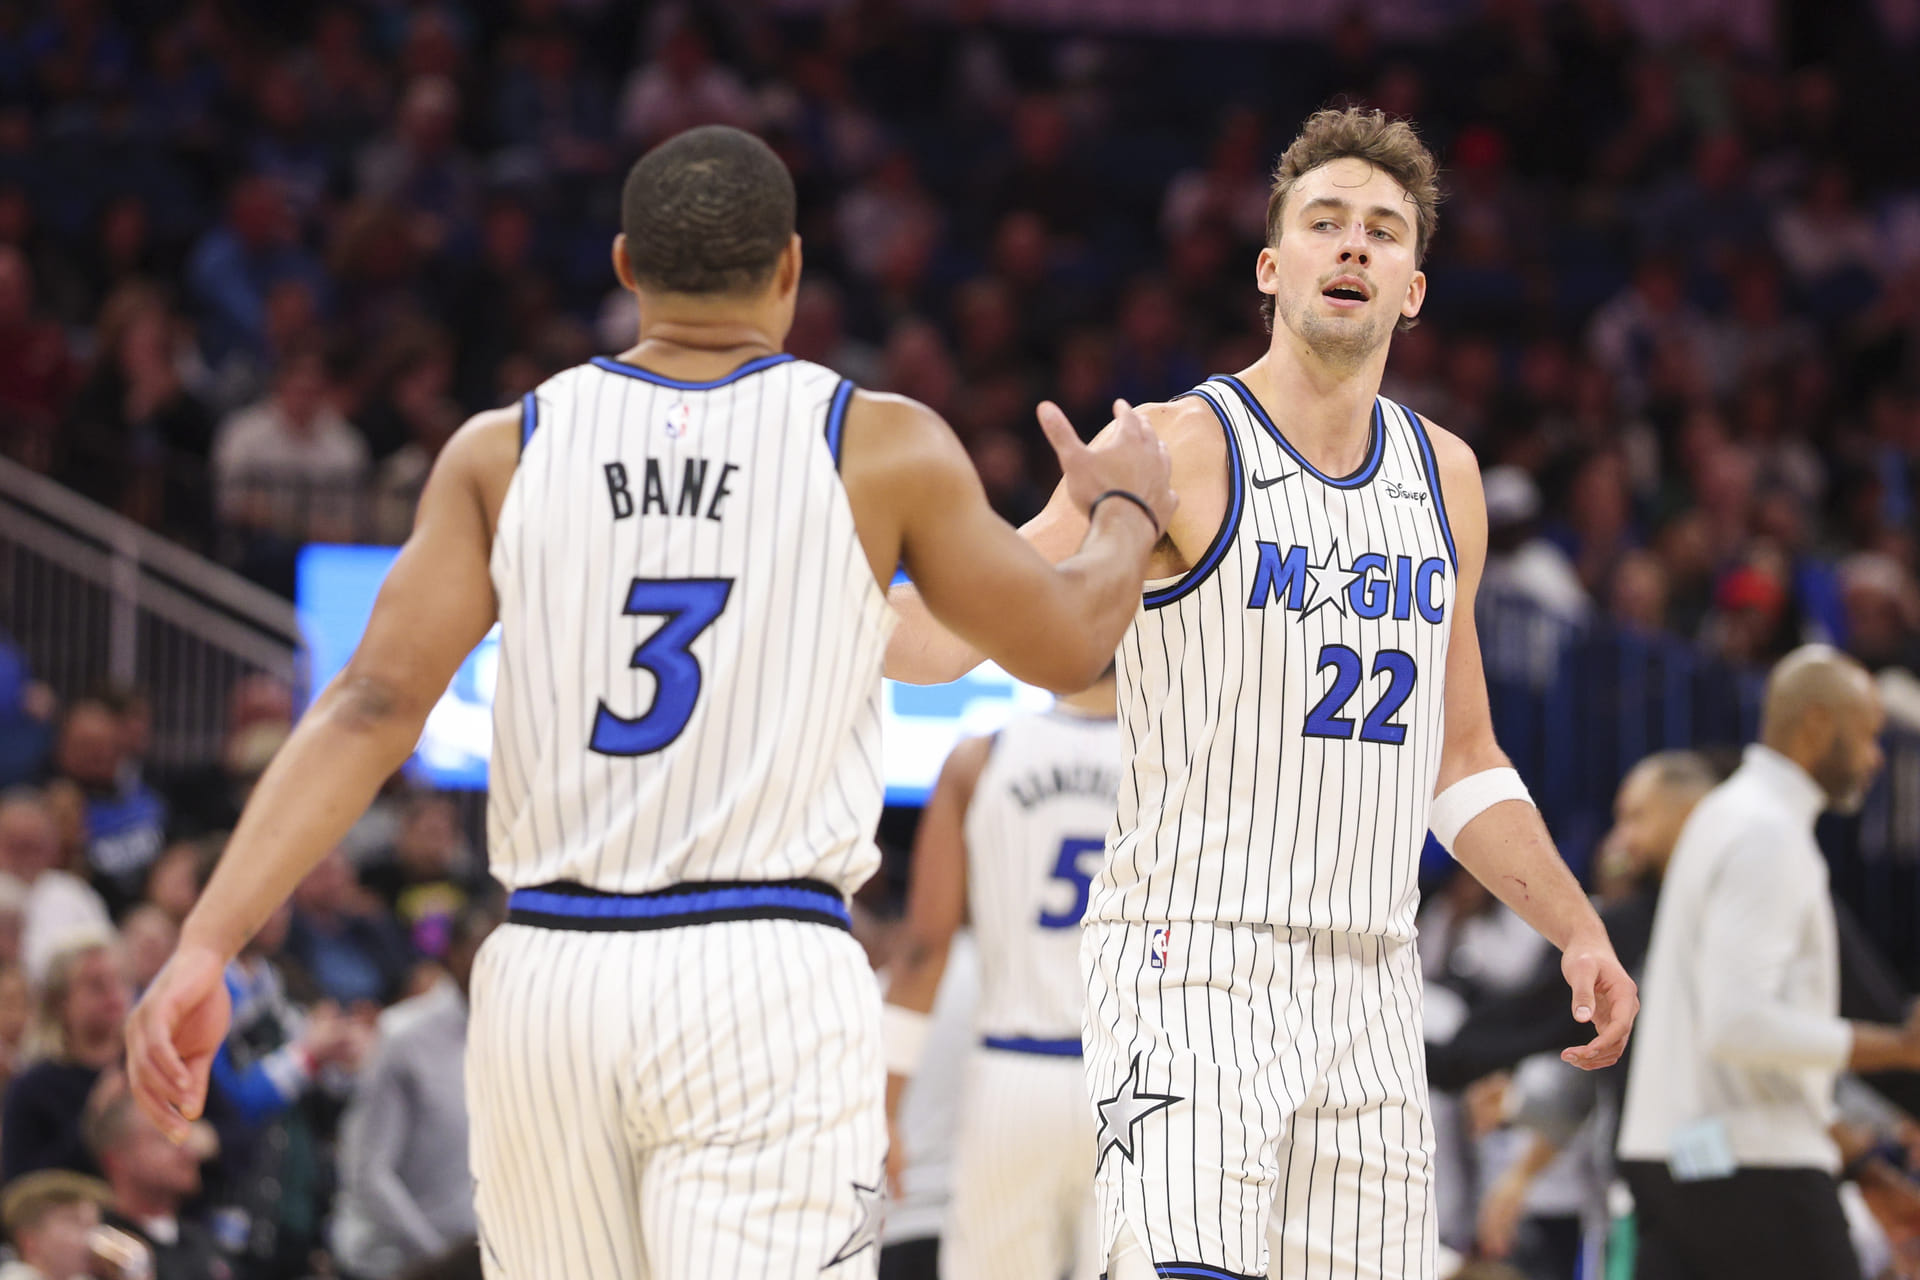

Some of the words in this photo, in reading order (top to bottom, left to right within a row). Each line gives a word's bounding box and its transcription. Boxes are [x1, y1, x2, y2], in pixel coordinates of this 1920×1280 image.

[603, 457, 740, 522] BANE
[588, 577, 735, 757] 3
[1301, 643, 1418, 745] 22
[1036, 837, 1106, 929] 5
